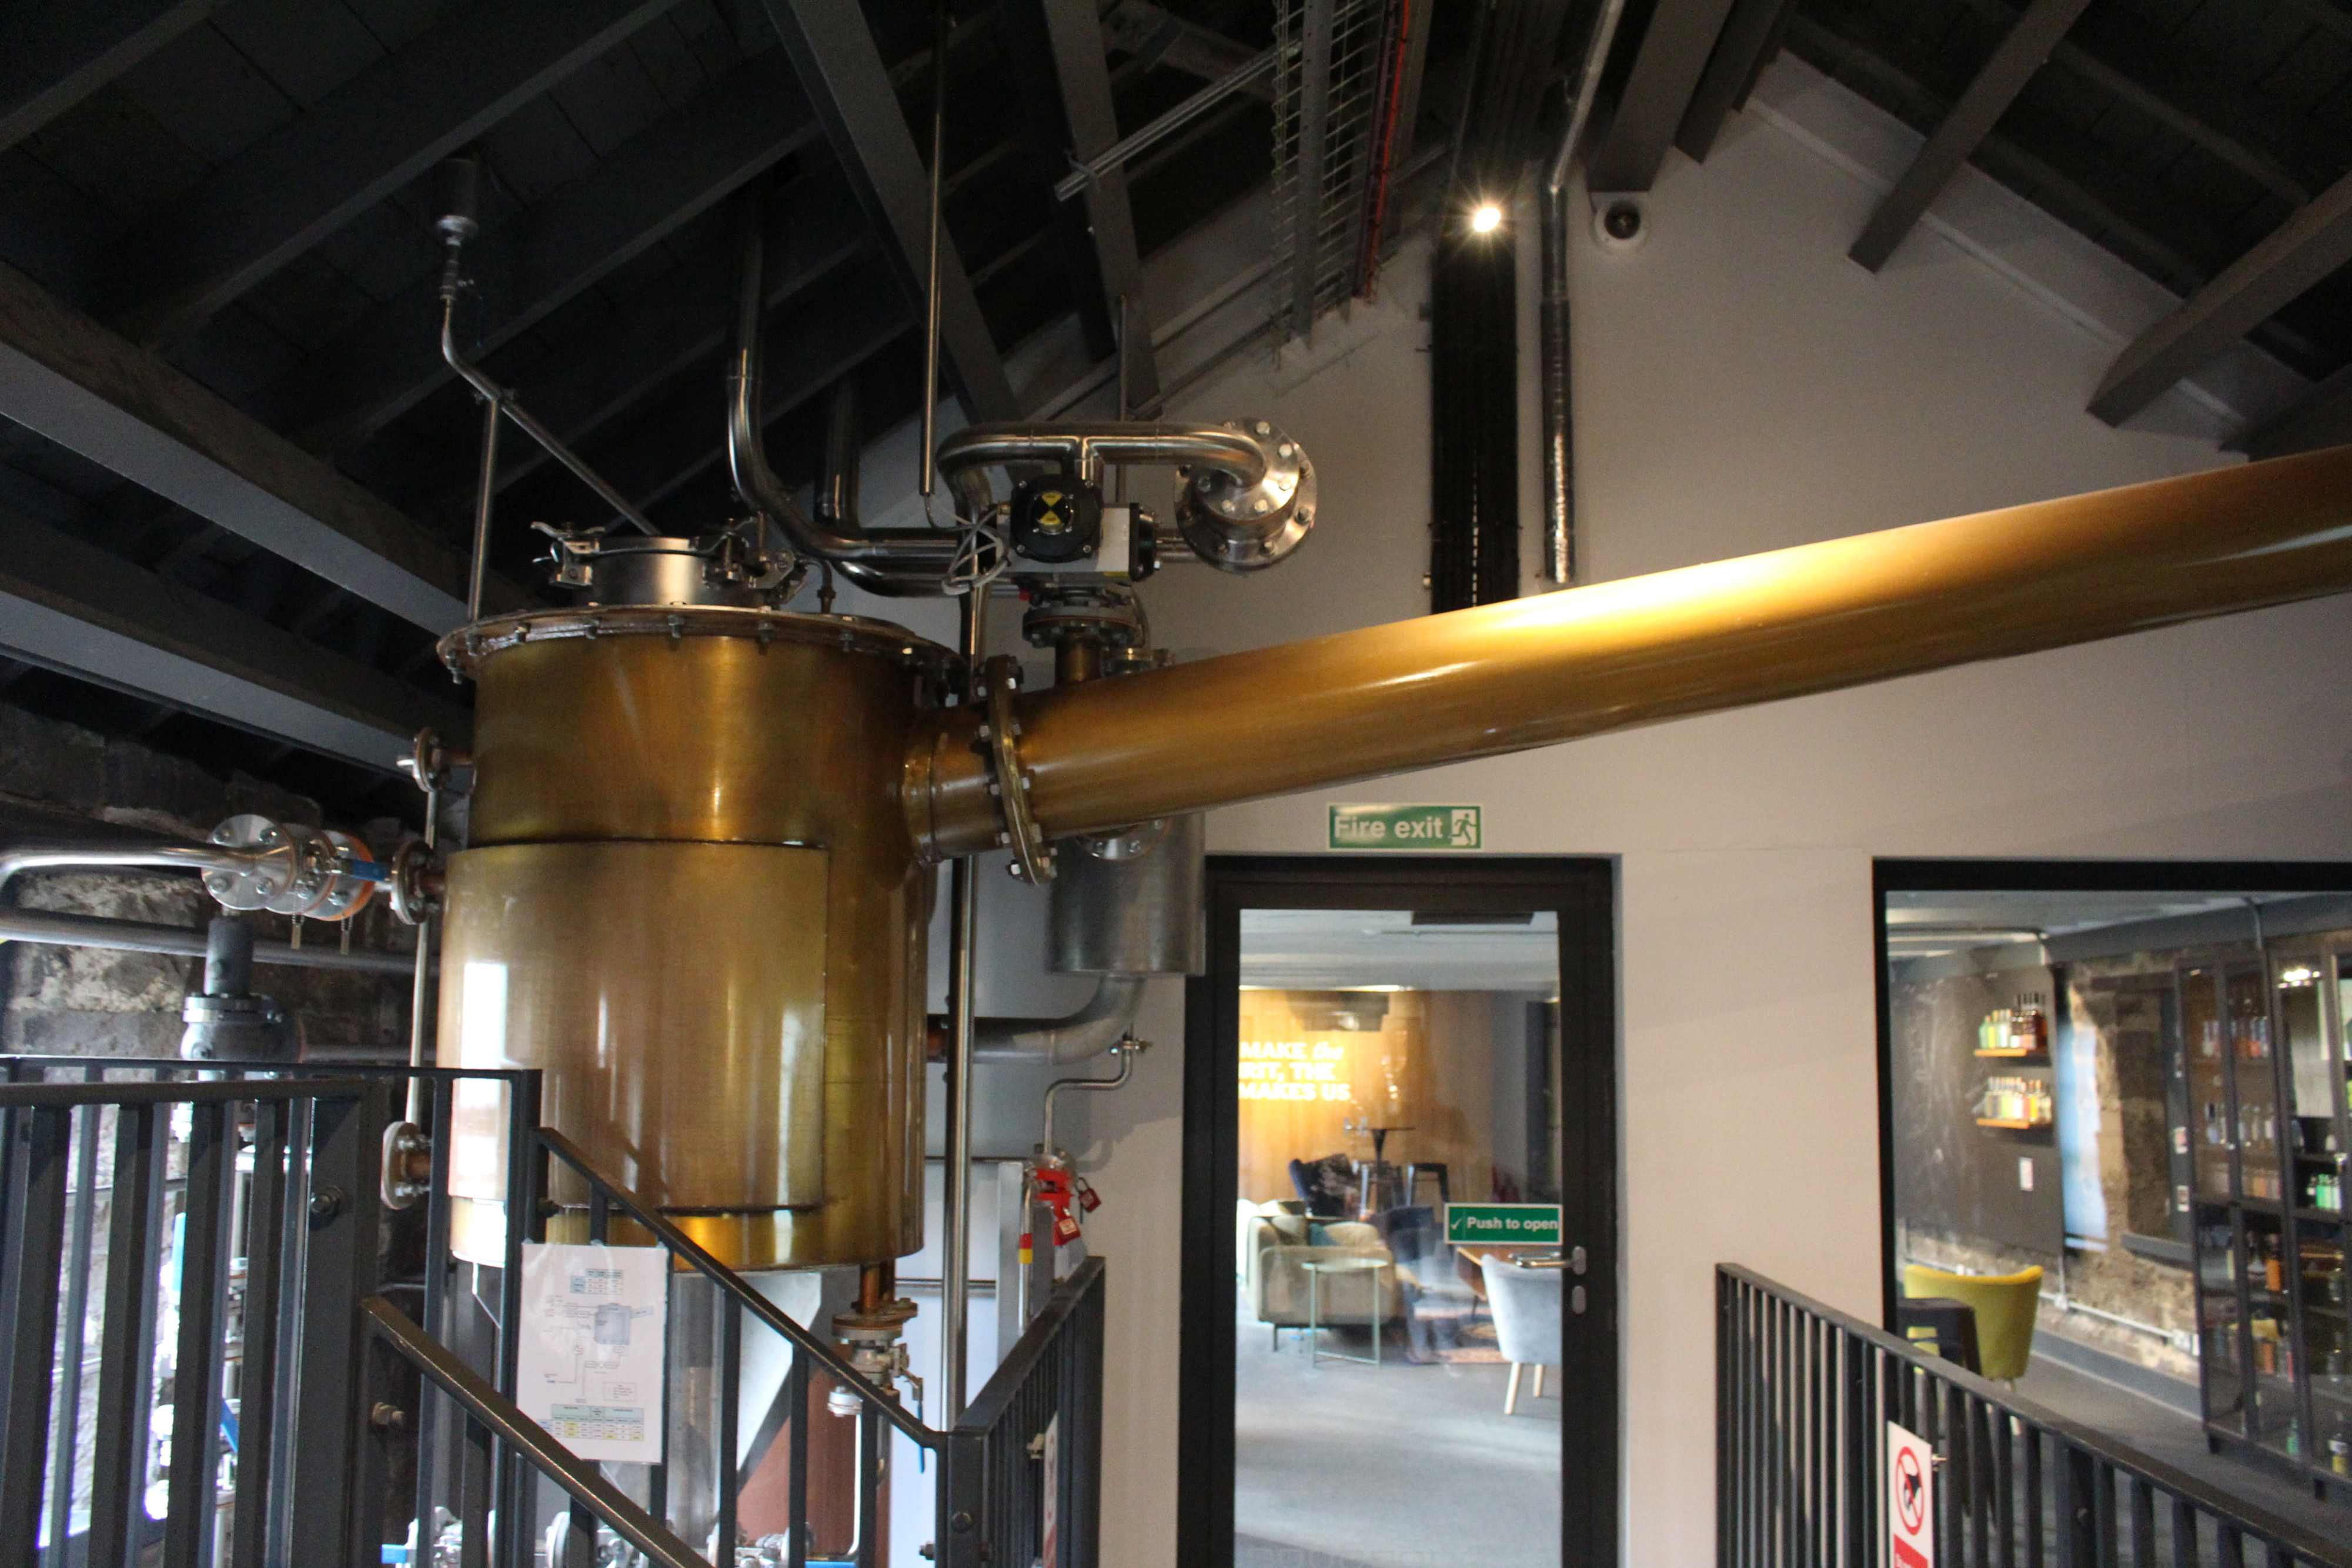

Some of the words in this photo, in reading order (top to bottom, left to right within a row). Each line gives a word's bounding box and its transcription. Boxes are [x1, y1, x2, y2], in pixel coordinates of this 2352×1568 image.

[1334, 815, 1386, 839] Fire
[1394, 816, 1443, 838] exit
[1241, 1042, 1307, 1058] MAKE
[1239, 1083, 1315, 1099] MAKES
[1322, 1084, 1350, 1100] US
[1467, 1216, 1502, 1229] Push
[1506, 1218, 1521, 1230] to
[1524, 1219, 1559, 1233] open
